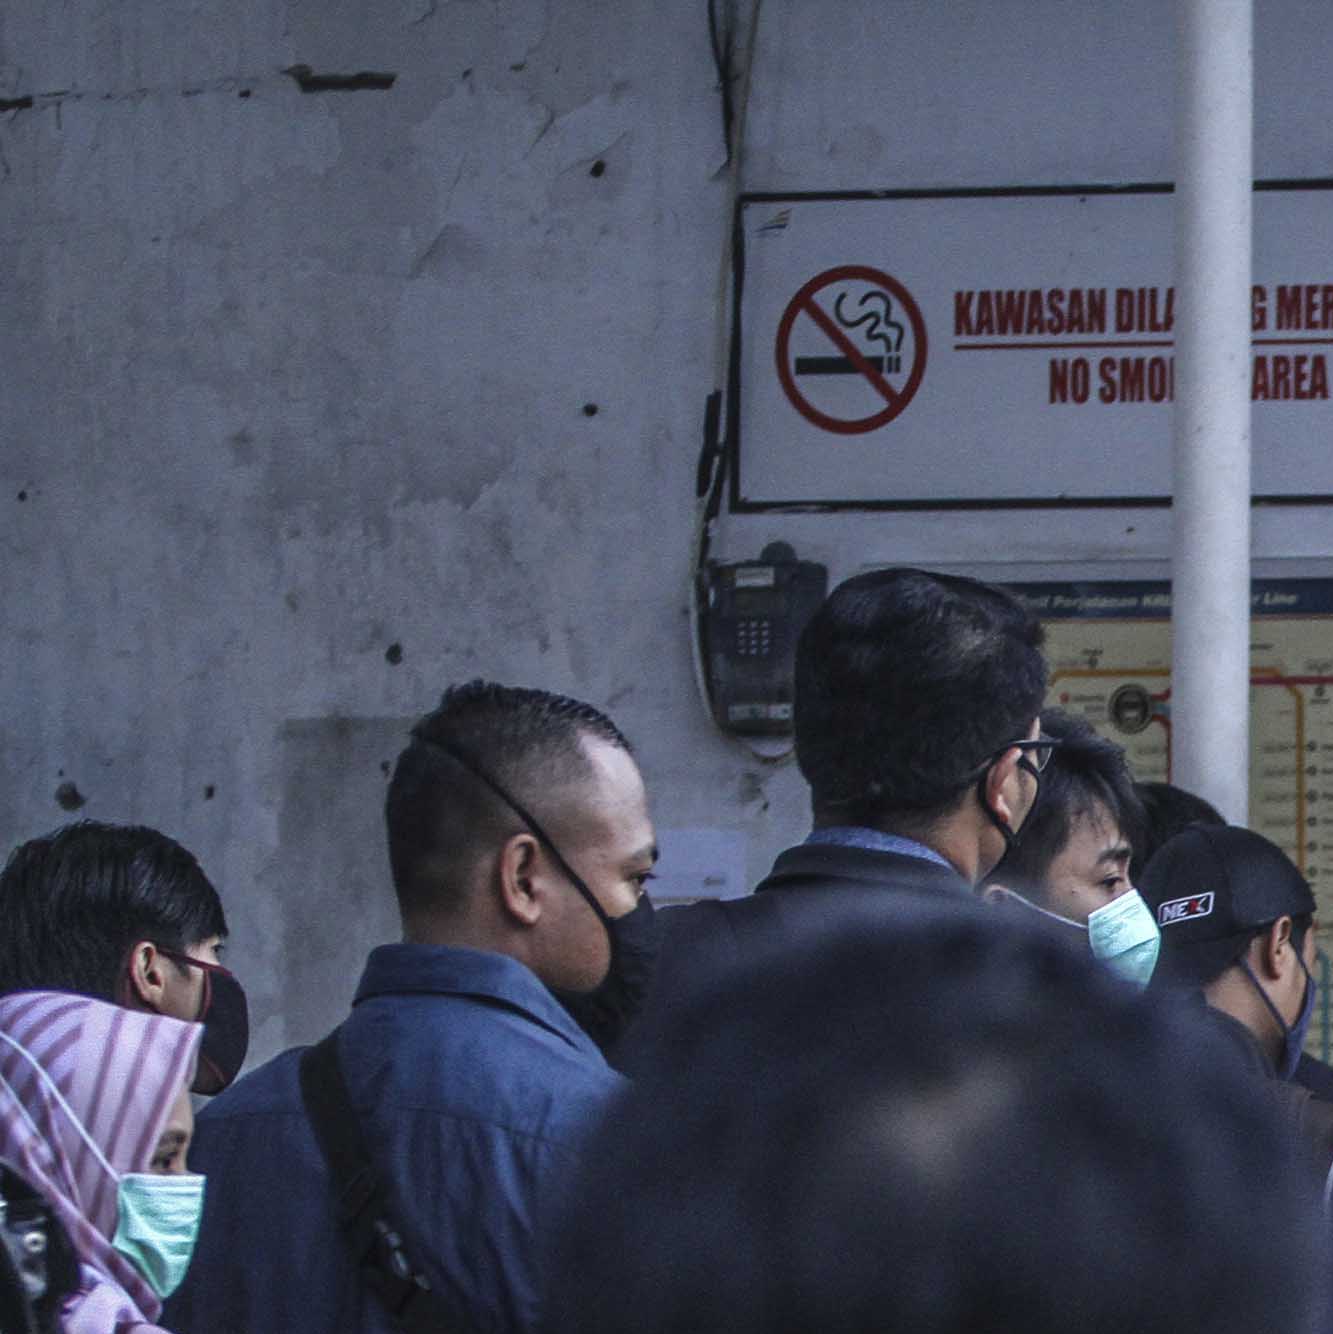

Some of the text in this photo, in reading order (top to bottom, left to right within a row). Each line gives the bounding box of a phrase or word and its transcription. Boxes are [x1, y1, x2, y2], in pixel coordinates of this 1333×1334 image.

[953, 289, 1105, 335] KAWASAN
[1049, 358, 1090, 403] NO
[1251, 355, 1329, 400] AREA
